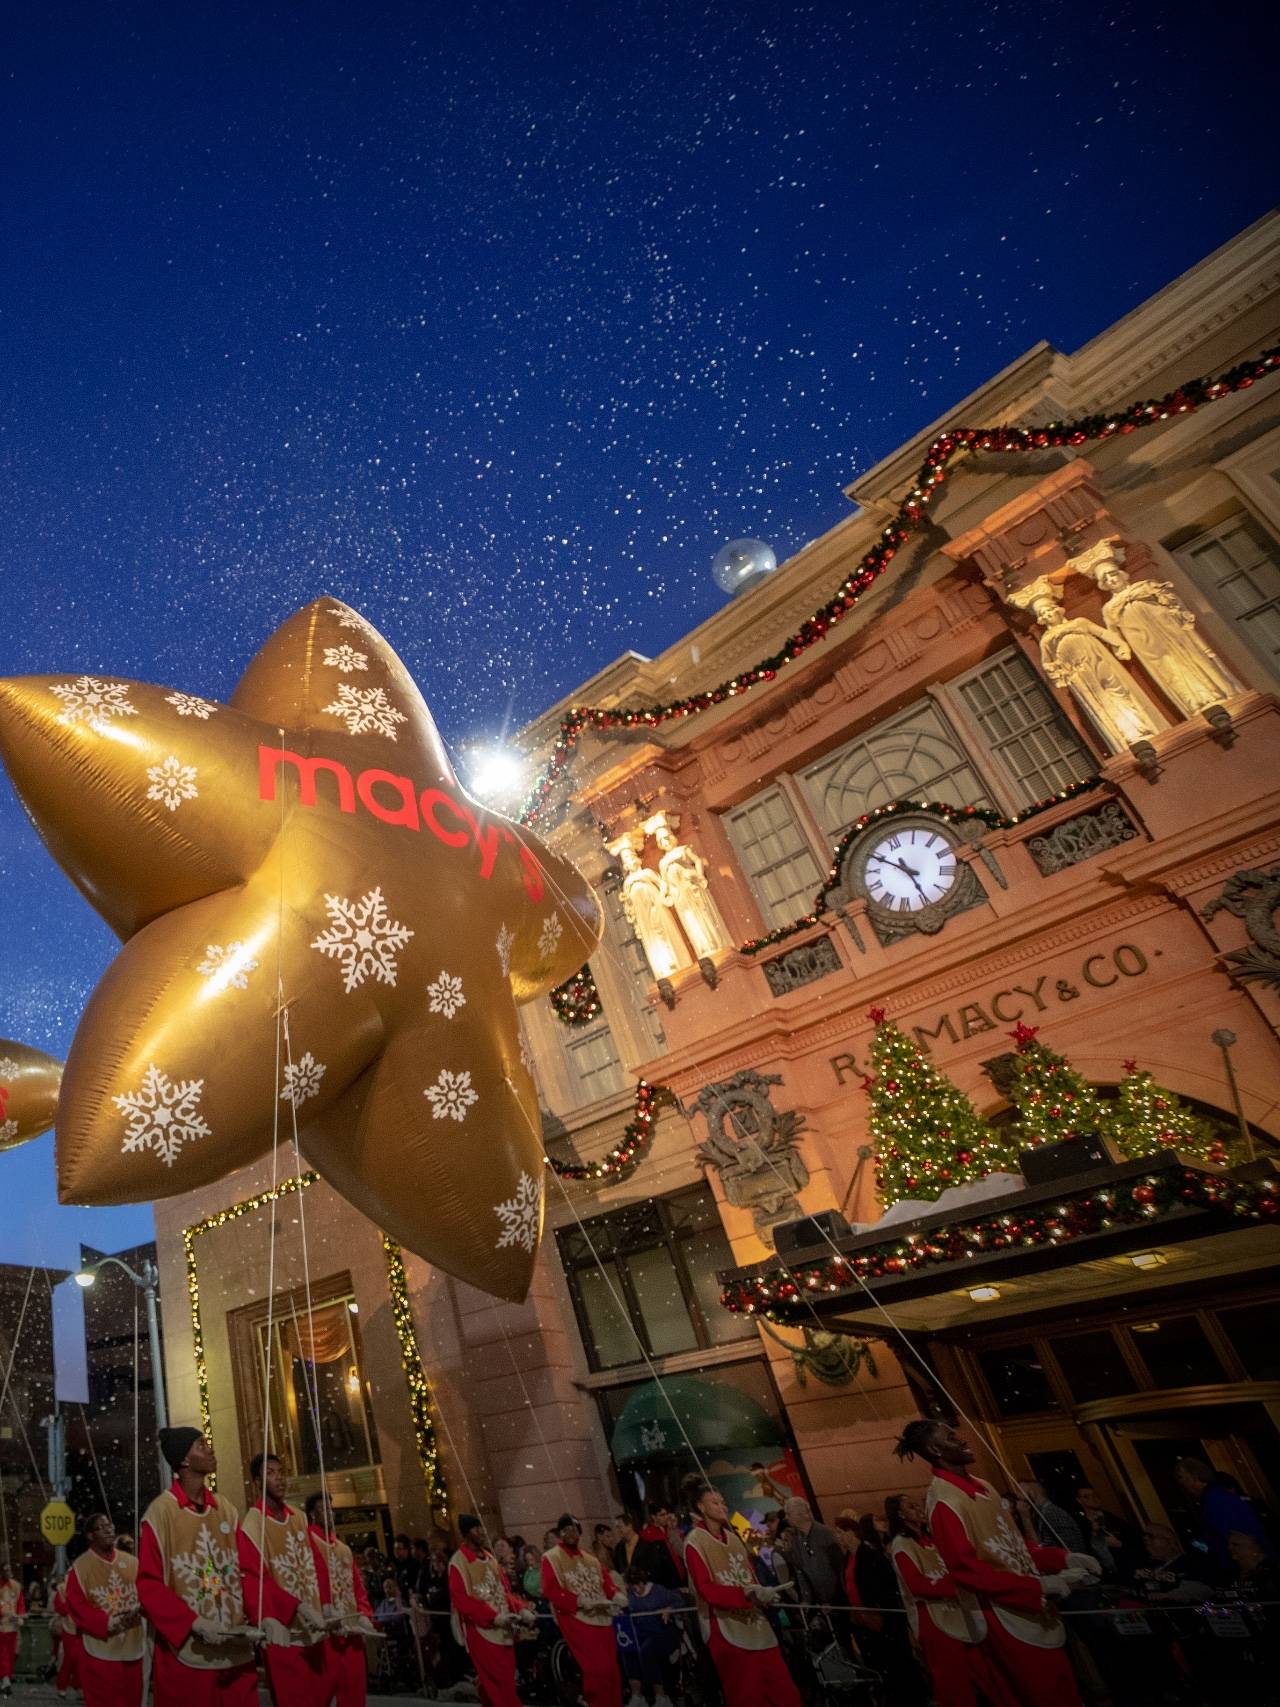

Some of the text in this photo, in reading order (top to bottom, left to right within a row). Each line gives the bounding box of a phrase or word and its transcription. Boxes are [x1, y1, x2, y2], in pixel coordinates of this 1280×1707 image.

[912, 976, 1047, 1054] MACY
[1055, 979, 1080, 1002] &
[45, 1515, 72, 1531] STOP
